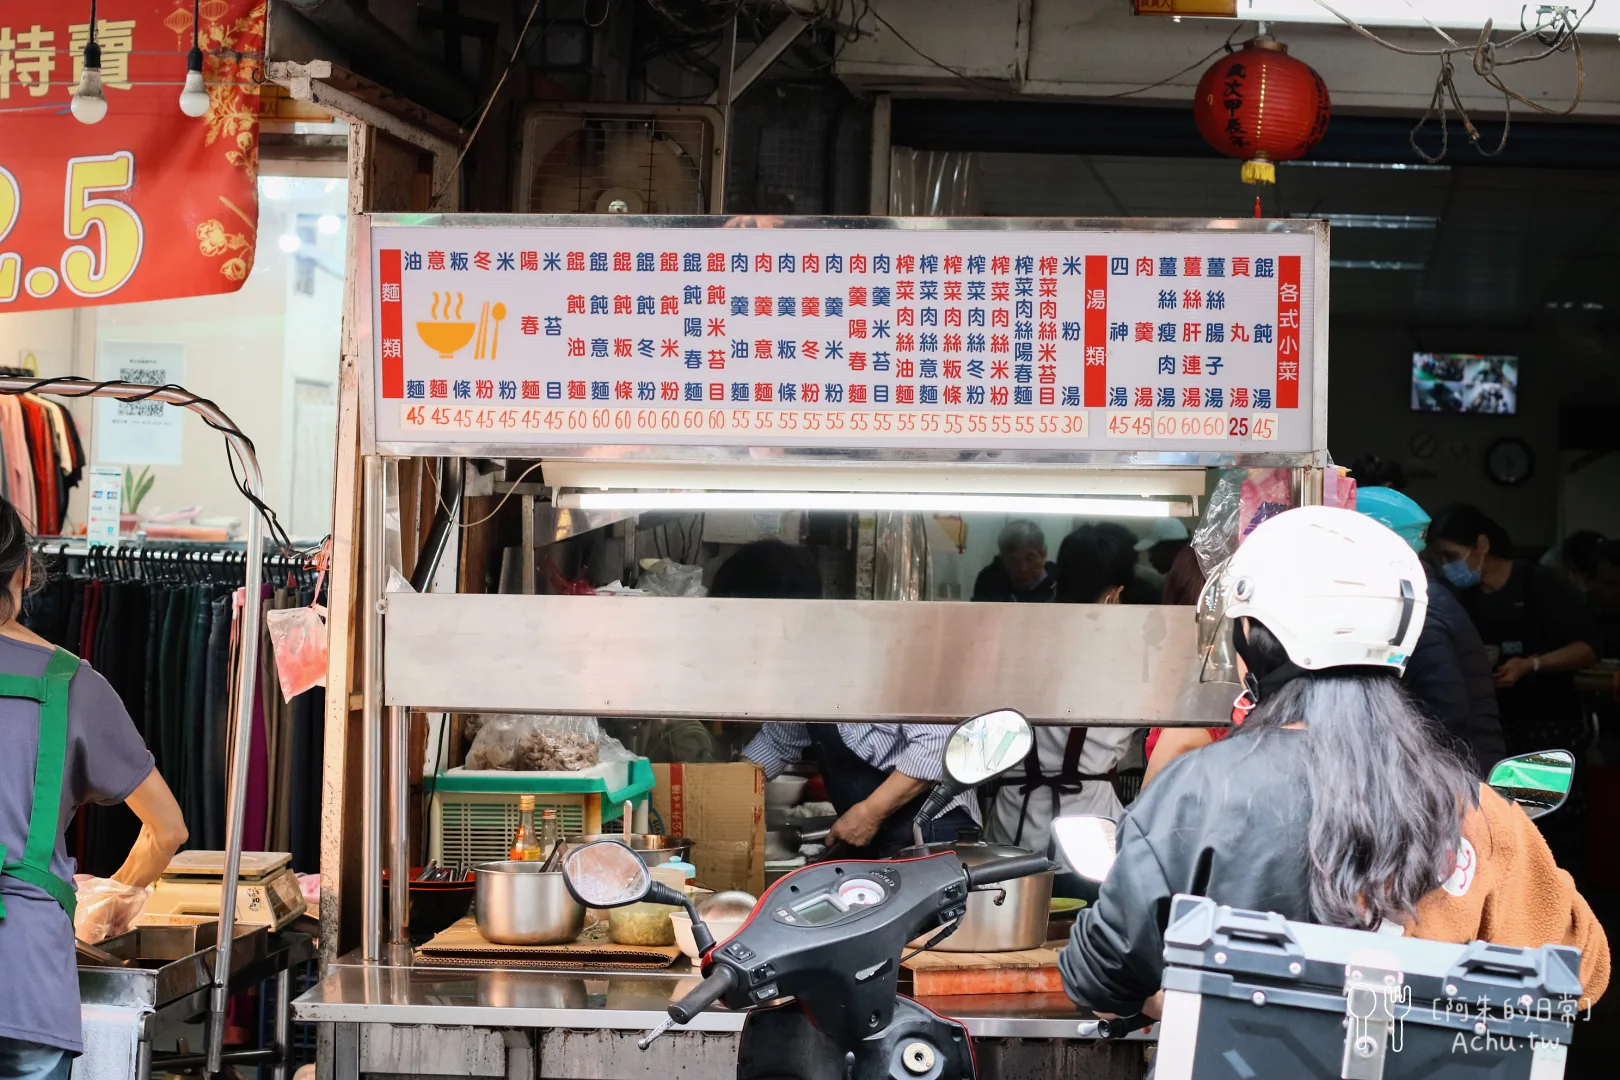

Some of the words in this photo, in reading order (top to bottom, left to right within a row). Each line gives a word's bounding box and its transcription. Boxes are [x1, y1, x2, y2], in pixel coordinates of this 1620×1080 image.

[0, 150, 144, 303] .5
[382, 283, 401, 358] 麵類
[405, 251, 426, 398] 油麵
[427, 250, 451, 398] 意麵
[473, 250, 494, 398] 冬粉
[497, 251, 517, 399] 米粉
[519, 250, 541, 399] 陽春麵
[542, 253, 562, 398] 米苔目
[566, 251, 587, 399] 餛飩油麵
[589, 252, 609, 399] 餛飩意麵
[636, 252, 656, 399] 餛飩冬粉
[659, 251, 680, 400] 餛飩米粉
[683, 252, 702, 400] 餛飩陽春麵
[706, 251, 726, 400] 餛飩米苔目
[731, 252, 749, 400] 肉羹油麵
[754, 252, 773, 402] 肉羹意麵
[778, 253, 796, 401] 肉羹粄條
[801, 253, 821, 402] 肉羹冬粉
[825, 254, 844, 402] 肉羹米粉
[848, 253, 867, 403] 肉羹陽春麵
[873, 253, 890, 402] 肉羹米苔目
[895, 254, 915, 404] 榨菜肉絲油麵
[919, 254, 938, 403] 榨菜肉絲意麵
[966, 255, 986, 404] 榨菜肉絲冬粉
[990, 255, 1011, 405] 榨菜肉絲米粉
[1014, 255, 1034, 404] 榨菜肉絲陽春麵
[1038, 255, 1059, 404] 榨菜肉絲米苔目
[1061, 256, 1081, 405] 米粉湯
[1085, 289, 1106, 366] 湯類
[1109, 257, 1129, 406] 四神湯
[1134, 256, 1154, 407] 肉羹湯
[1157, 256, 1177, 407] 薑絲瘦肉湯
[1181, 255, 1202, 407] 薑絲肝連湯
[1205, 257, 1225, 407] 薑絲腸子湯
[1229, 256, 1251, 408] 貢丸湯
[1252, 257, 1274, 408] 餛飩湯
[1278, 282, 1299, 381] 各式小菜
[406, 406, 425, 426] 45
[431, 408, 451, 425] 45
[454, 409, 473, 428] 45
[476, 410, 495, 428] 45
[499, 410, 519, 428] 45
[521, 410, 542, 428] 45
[544, 411, 564, 430] 45
[568, 410, 586, 429] 60
[592, 408, 610, 428] 60
[615, 410, 631, 429] 60
[638, 410, 656, 428] 60
[662, 410, 679, 429] 60
[684, 411, 702, 428] 60
[709, 410, 724, 428] 60
[732, 410, 749, 428] 55
[756, 412, 773, 428] 55
[780, 412, 796, 430] 55
[804, 412, 820, 430] 55
[827, 412, 844, 430] 55
[851, 413, 868, 430] 55
[874, 413, 892, 430] 55
[898, 414, 916, 430] 55
[921, 414, 939, 431] 55
[944, 414, 963, 434] 55
[968, 415, 987, 432] 55
[992, 415, 1010, 434] 55
[1016, 416, 1034, 433] 55
[1040, 416, 1059, 432] 55
[1062, 416, 1082, 434] 30
[1109, 416, 1130, 434] 45
[1132, 417, 1151, 434] 45
[1158, 418, 1176, 434] 60
[1182, 418, 1201, 434] 60
[1204, 417, 1224, 435] 60
[1229, 417, 1249, 436] 25
[1252, 419, 1274, 438] 45
